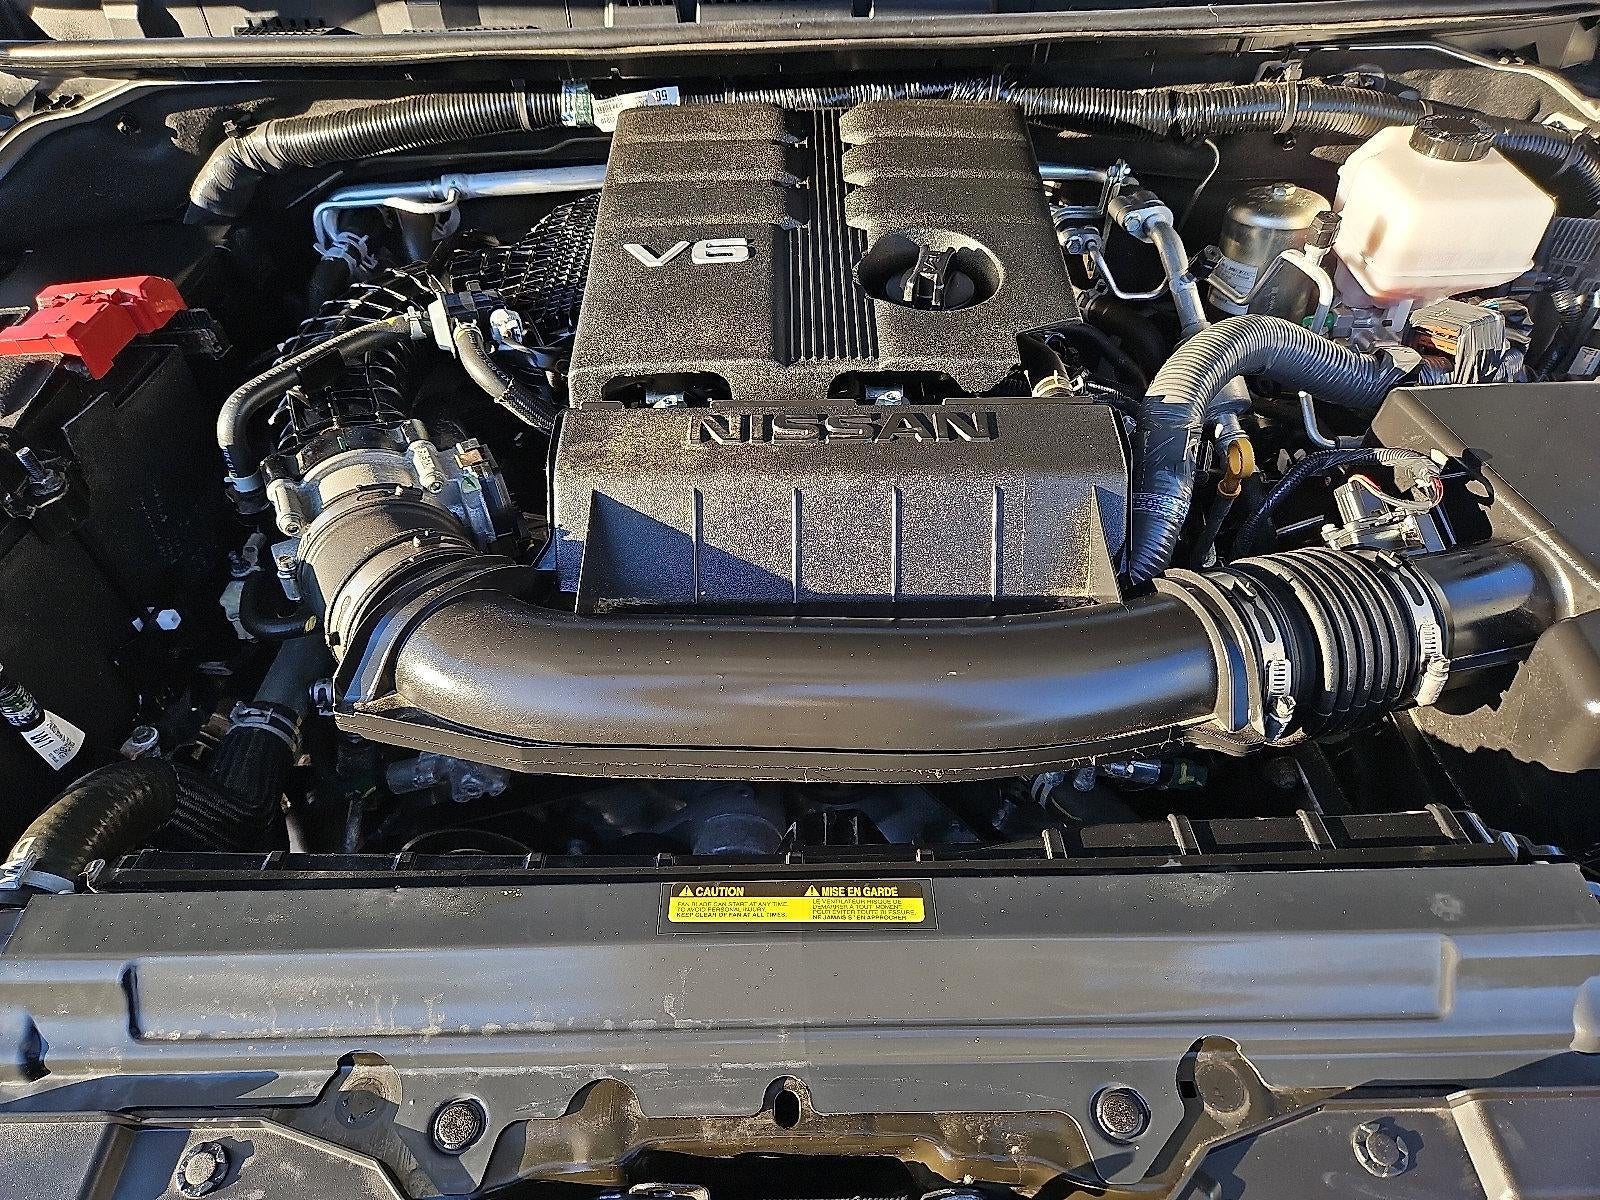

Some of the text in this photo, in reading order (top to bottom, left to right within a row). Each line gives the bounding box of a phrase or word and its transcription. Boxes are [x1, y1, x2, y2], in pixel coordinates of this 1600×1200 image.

[623, 237, 748, 267] V6
[689, 411, 996, 445] NISSAN
[695, 886, 745, 897] CAUTION
[822, 886, 898, 896] MISE EN GARDE
